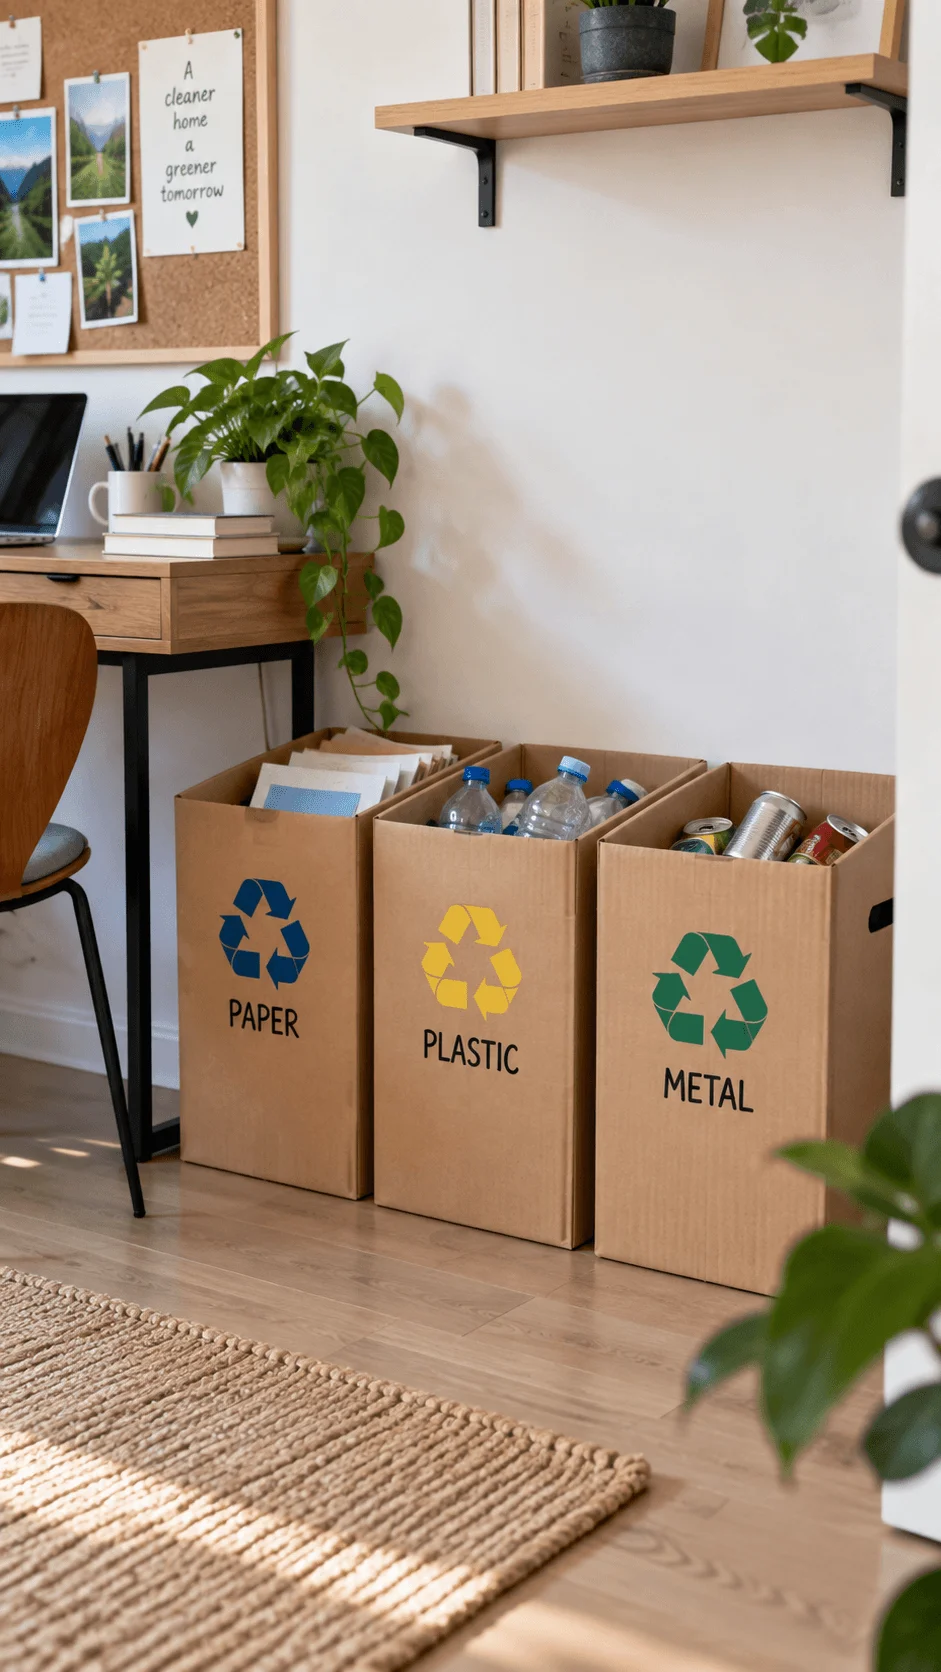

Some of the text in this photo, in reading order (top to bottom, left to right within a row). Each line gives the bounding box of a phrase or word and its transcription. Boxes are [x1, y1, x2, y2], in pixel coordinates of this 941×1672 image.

[184, 61, 193, 79] A
[165, 86, 216, 107] cleaner
[173, 111, 208, 130] home
[185, 140, 194, 152] a
[165, 160, 217, 184] greener
[161, 185, 224, 203] tomorrow
[229, 998, 300, 1039] PAPER
[423, 1028, 519, 1075] PLASTIC
[663, 1067, 754, 1113] METAL
